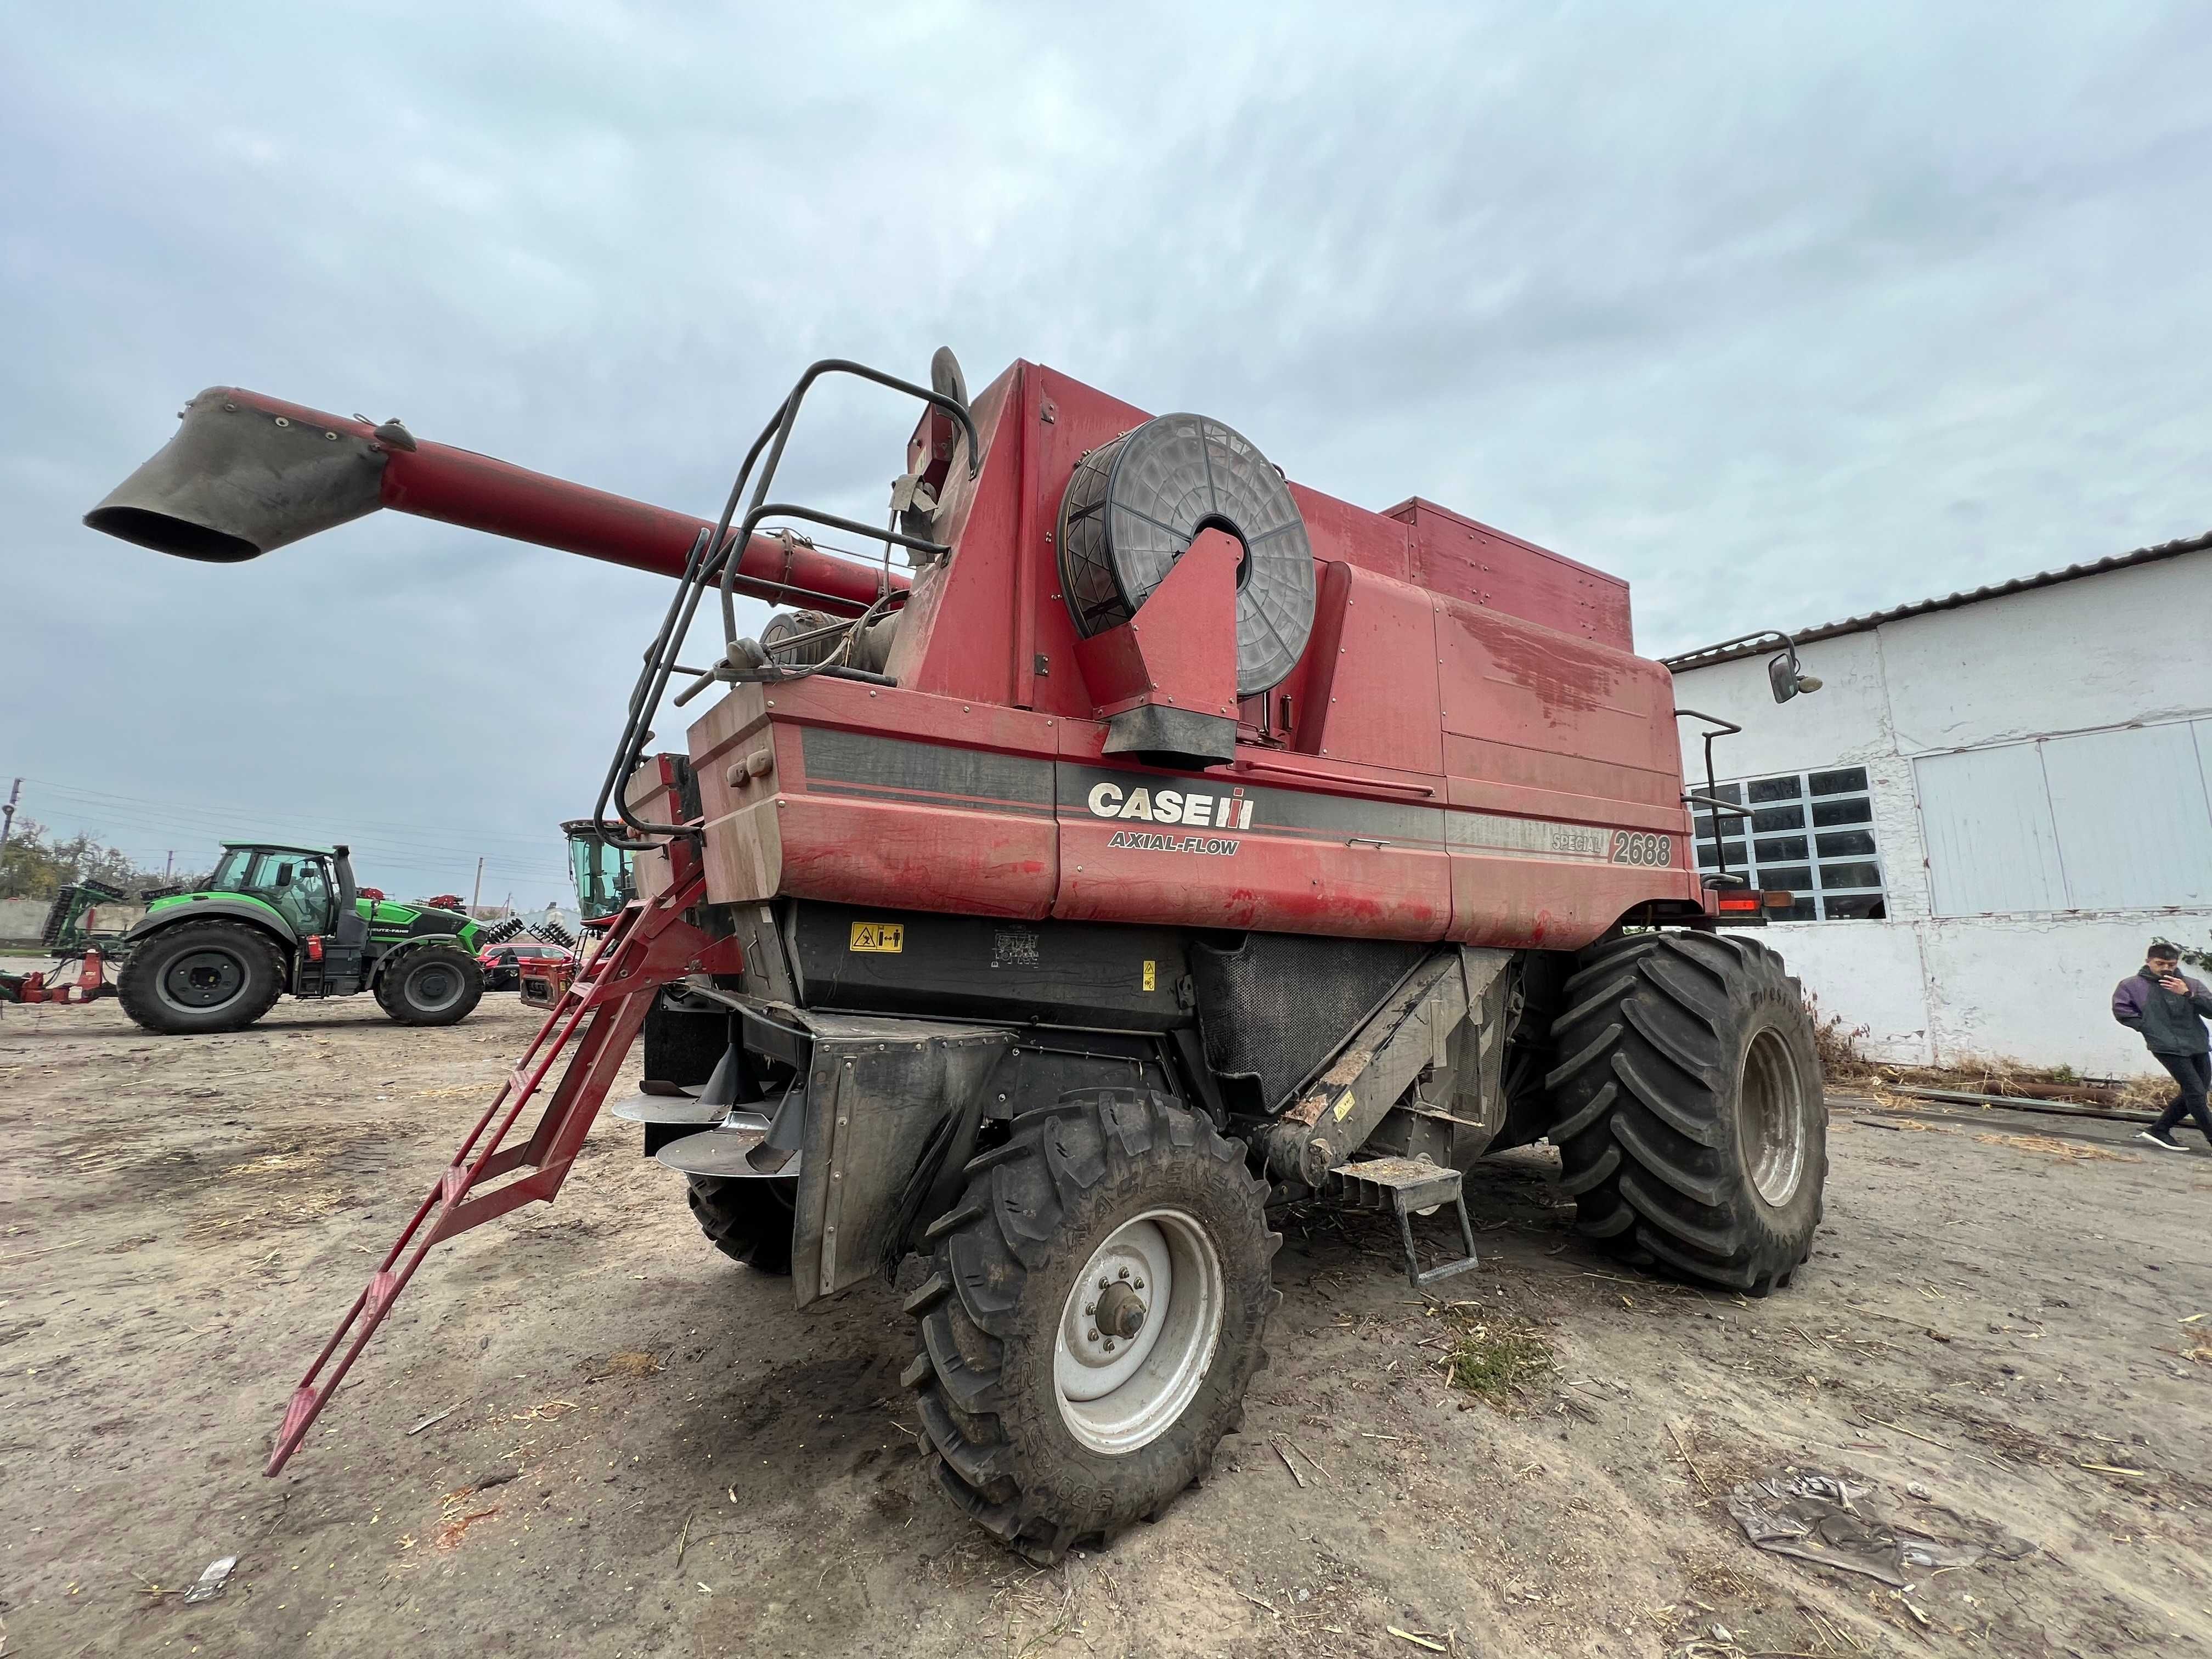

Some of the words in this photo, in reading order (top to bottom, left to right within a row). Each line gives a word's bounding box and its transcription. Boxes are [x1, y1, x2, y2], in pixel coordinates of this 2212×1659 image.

[1088, 783, 1213, 826] CASE
[1108, 831, 1240, 856] AXIAL-FLOW
[1552, 833, 1601, 854] SPECIAL
[1612, 830, 1671, 868] 2688
